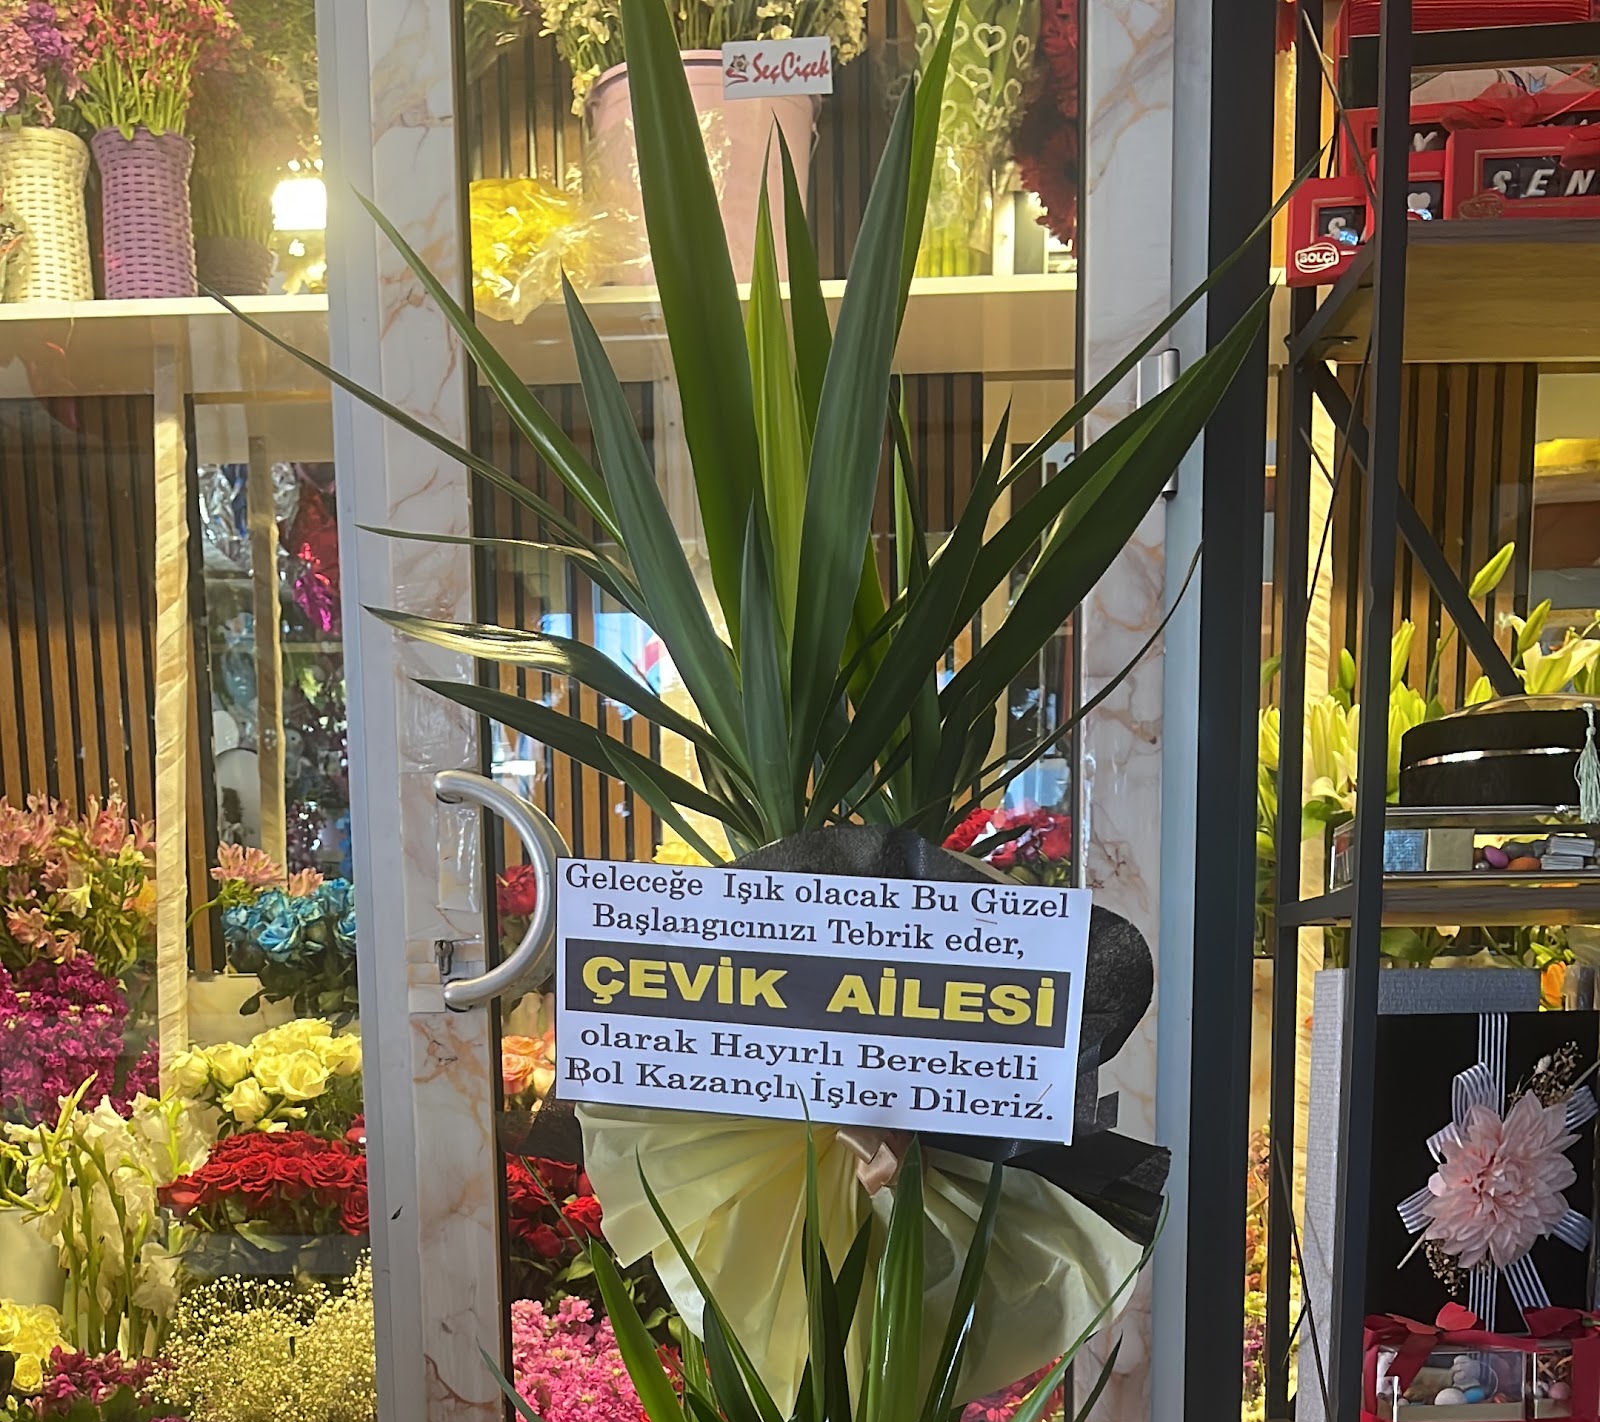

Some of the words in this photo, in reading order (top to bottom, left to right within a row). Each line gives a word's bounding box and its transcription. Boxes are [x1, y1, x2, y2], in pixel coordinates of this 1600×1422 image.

[565, 863, 703, 899] Geleceğe
[723, 873, 784, 904] Işık
[795, 878, 900, 909] olacak
[912, 884, 959, 912] Bu
[970, 888, 1070, 919] Güzel
[592, 903, 817, 941] Başlangıcınızı
[828, 919, 934, 950] Tebrik
[944, 927, 1025, 959] eder,
[582, 956, 788, 1009] ÇEVİK
[826, 967, 1055, 1027] AİLESİ
[580, 1023, 698, 1055] olarak
[711, 1031, 843, 1067] Hayırlı
[857, 1044, 1039, 1081] Bereketli
[565, 1056, 624, 1085] Bol
[636, 1063, 798, 1102] Kazançlı
[810, 1071, 898, 1109] İşler
[909, 1086, 1054, 1121] Dileriz.
